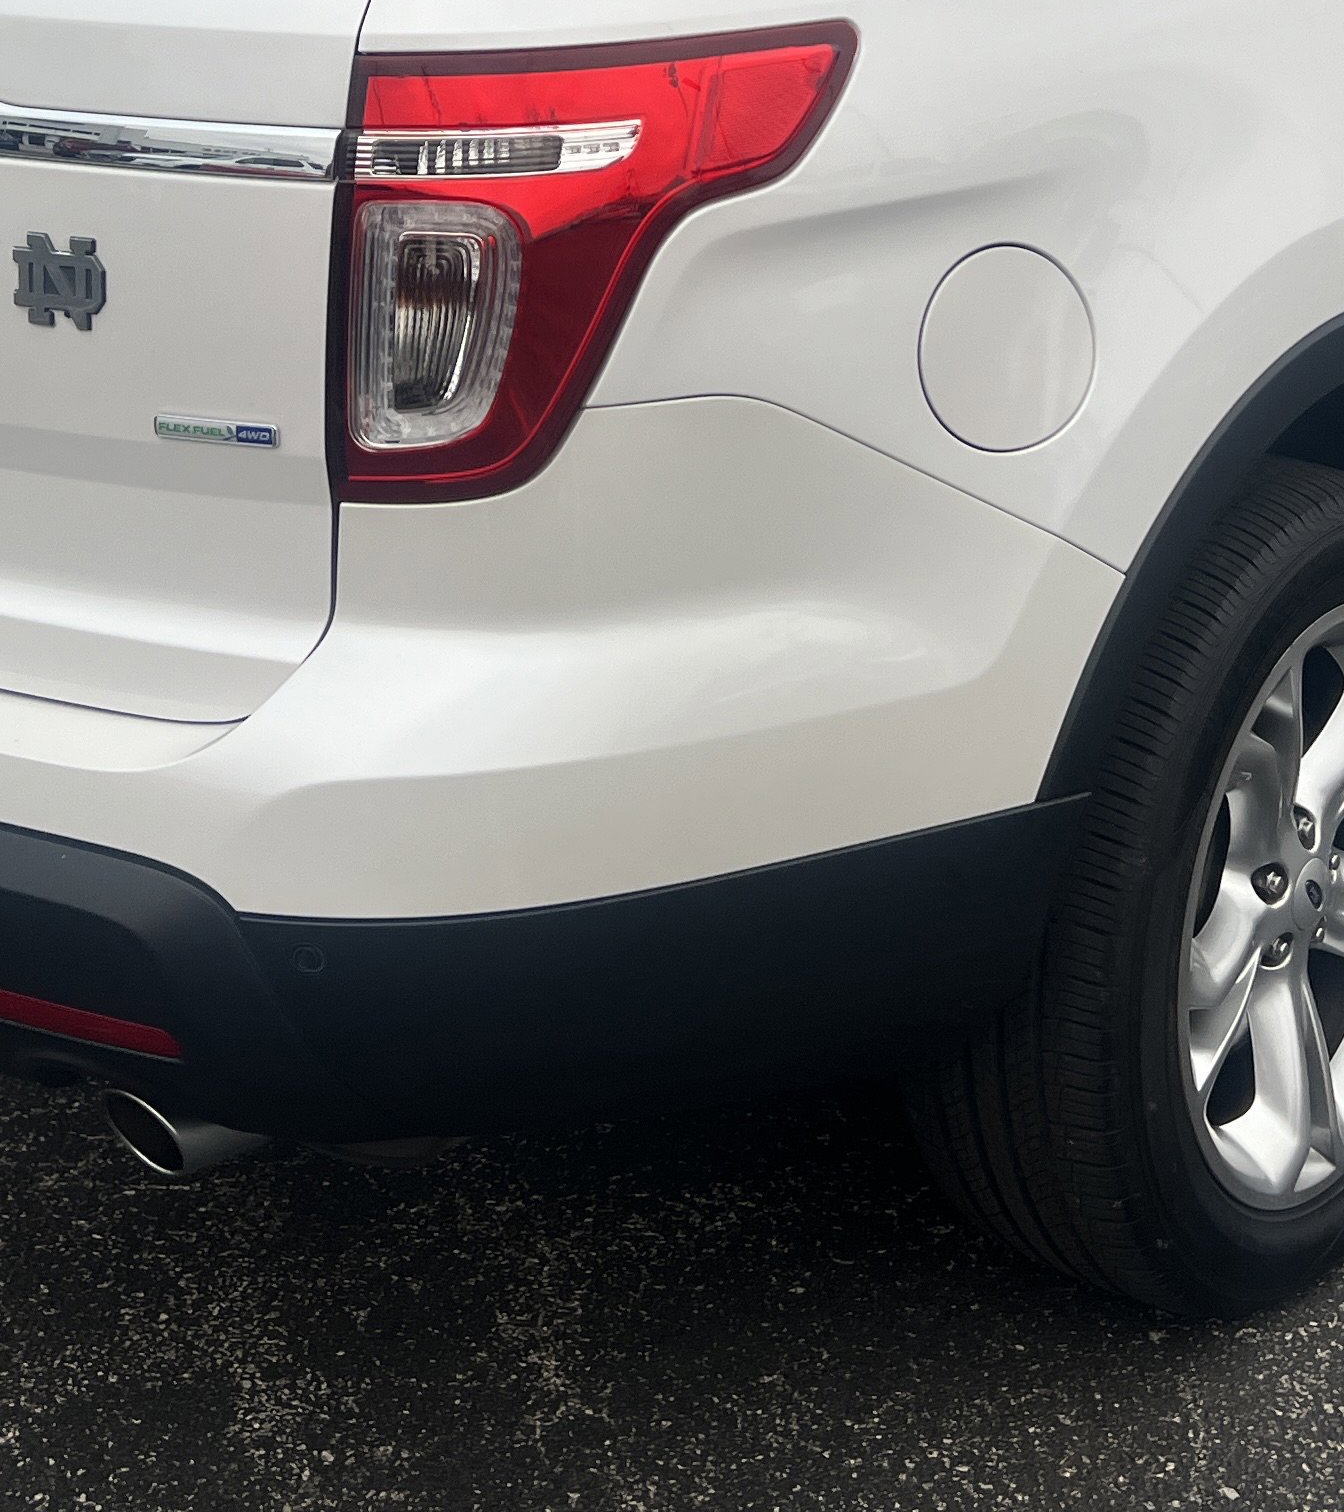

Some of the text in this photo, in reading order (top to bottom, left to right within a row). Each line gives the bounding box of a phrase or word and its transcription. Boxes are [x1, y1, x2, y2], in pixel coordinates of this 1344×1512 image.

[158, 422, 271, 442] FLEX FUEL 4WD
